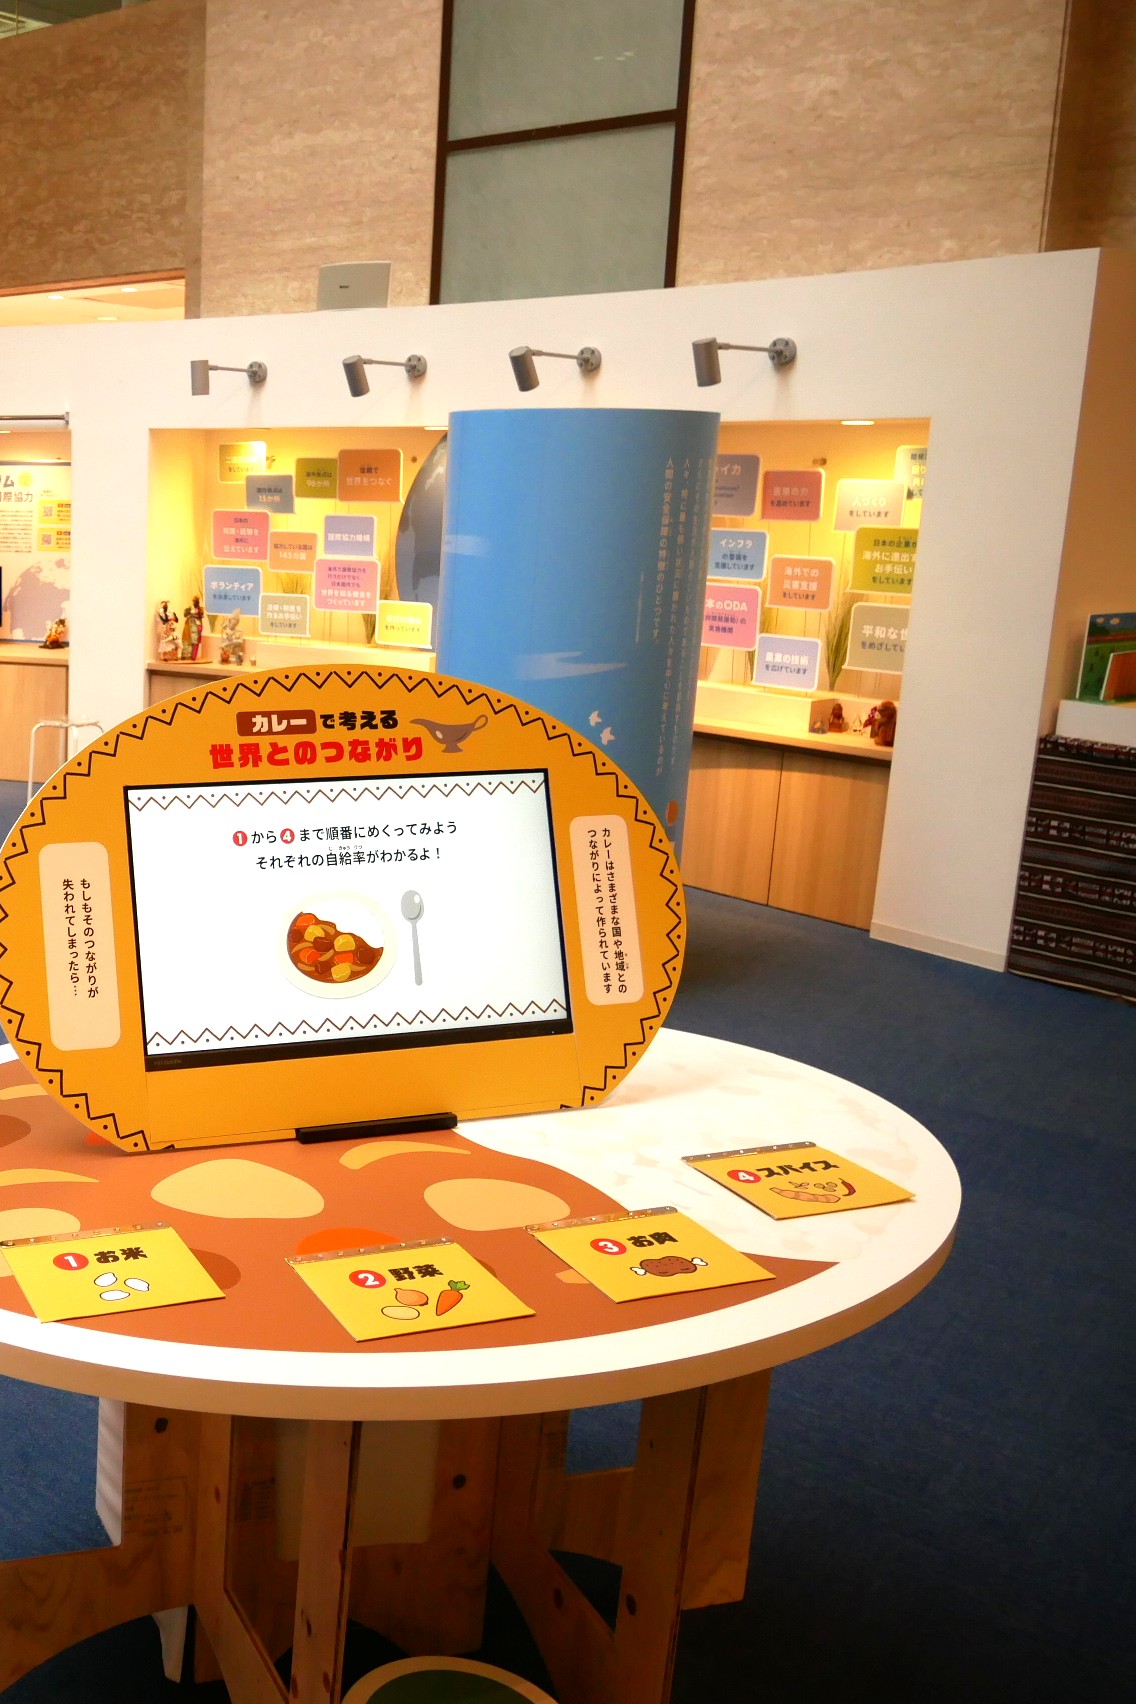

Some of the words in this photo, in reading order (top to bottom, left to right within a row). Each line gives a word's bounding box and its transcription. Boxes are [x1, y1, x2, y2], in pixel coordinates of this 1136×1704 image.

[346, 477, 392, 487] 世界をつなぐ
[851, 496, 887, 507] 人づくり
[849, 509, 889, 518] をしています
[327, 532, 370, 542] 国際協力機構
[720, 539, 753, 549] インフラ
[784, 566, 820, 578] 海外での
[874, 563, 913, 574] お手伝い
[210, 581, 254, 591] ボランティア
[783, 579, 818, 591] 災害支援
[782, 592, 816, 600] をしています
[209, 737, 423, 769] 世界とのつながり
[256, 848, 441, 870] それぞれの自給率がわかるよ！
[587, 829, 613, 994] つながりによって作られています
[602, 827, 627, 994] カレーはさまざまな国や地域との
[80, 878, 99, 998] もしもそのつながりが
[756, 1160, 840, 1179] スパイス
[626, 1231, 679, 1248] お肉
[93, 1246, 148, 1264] お米
[387, 1263, 444, 1282] 野菜
